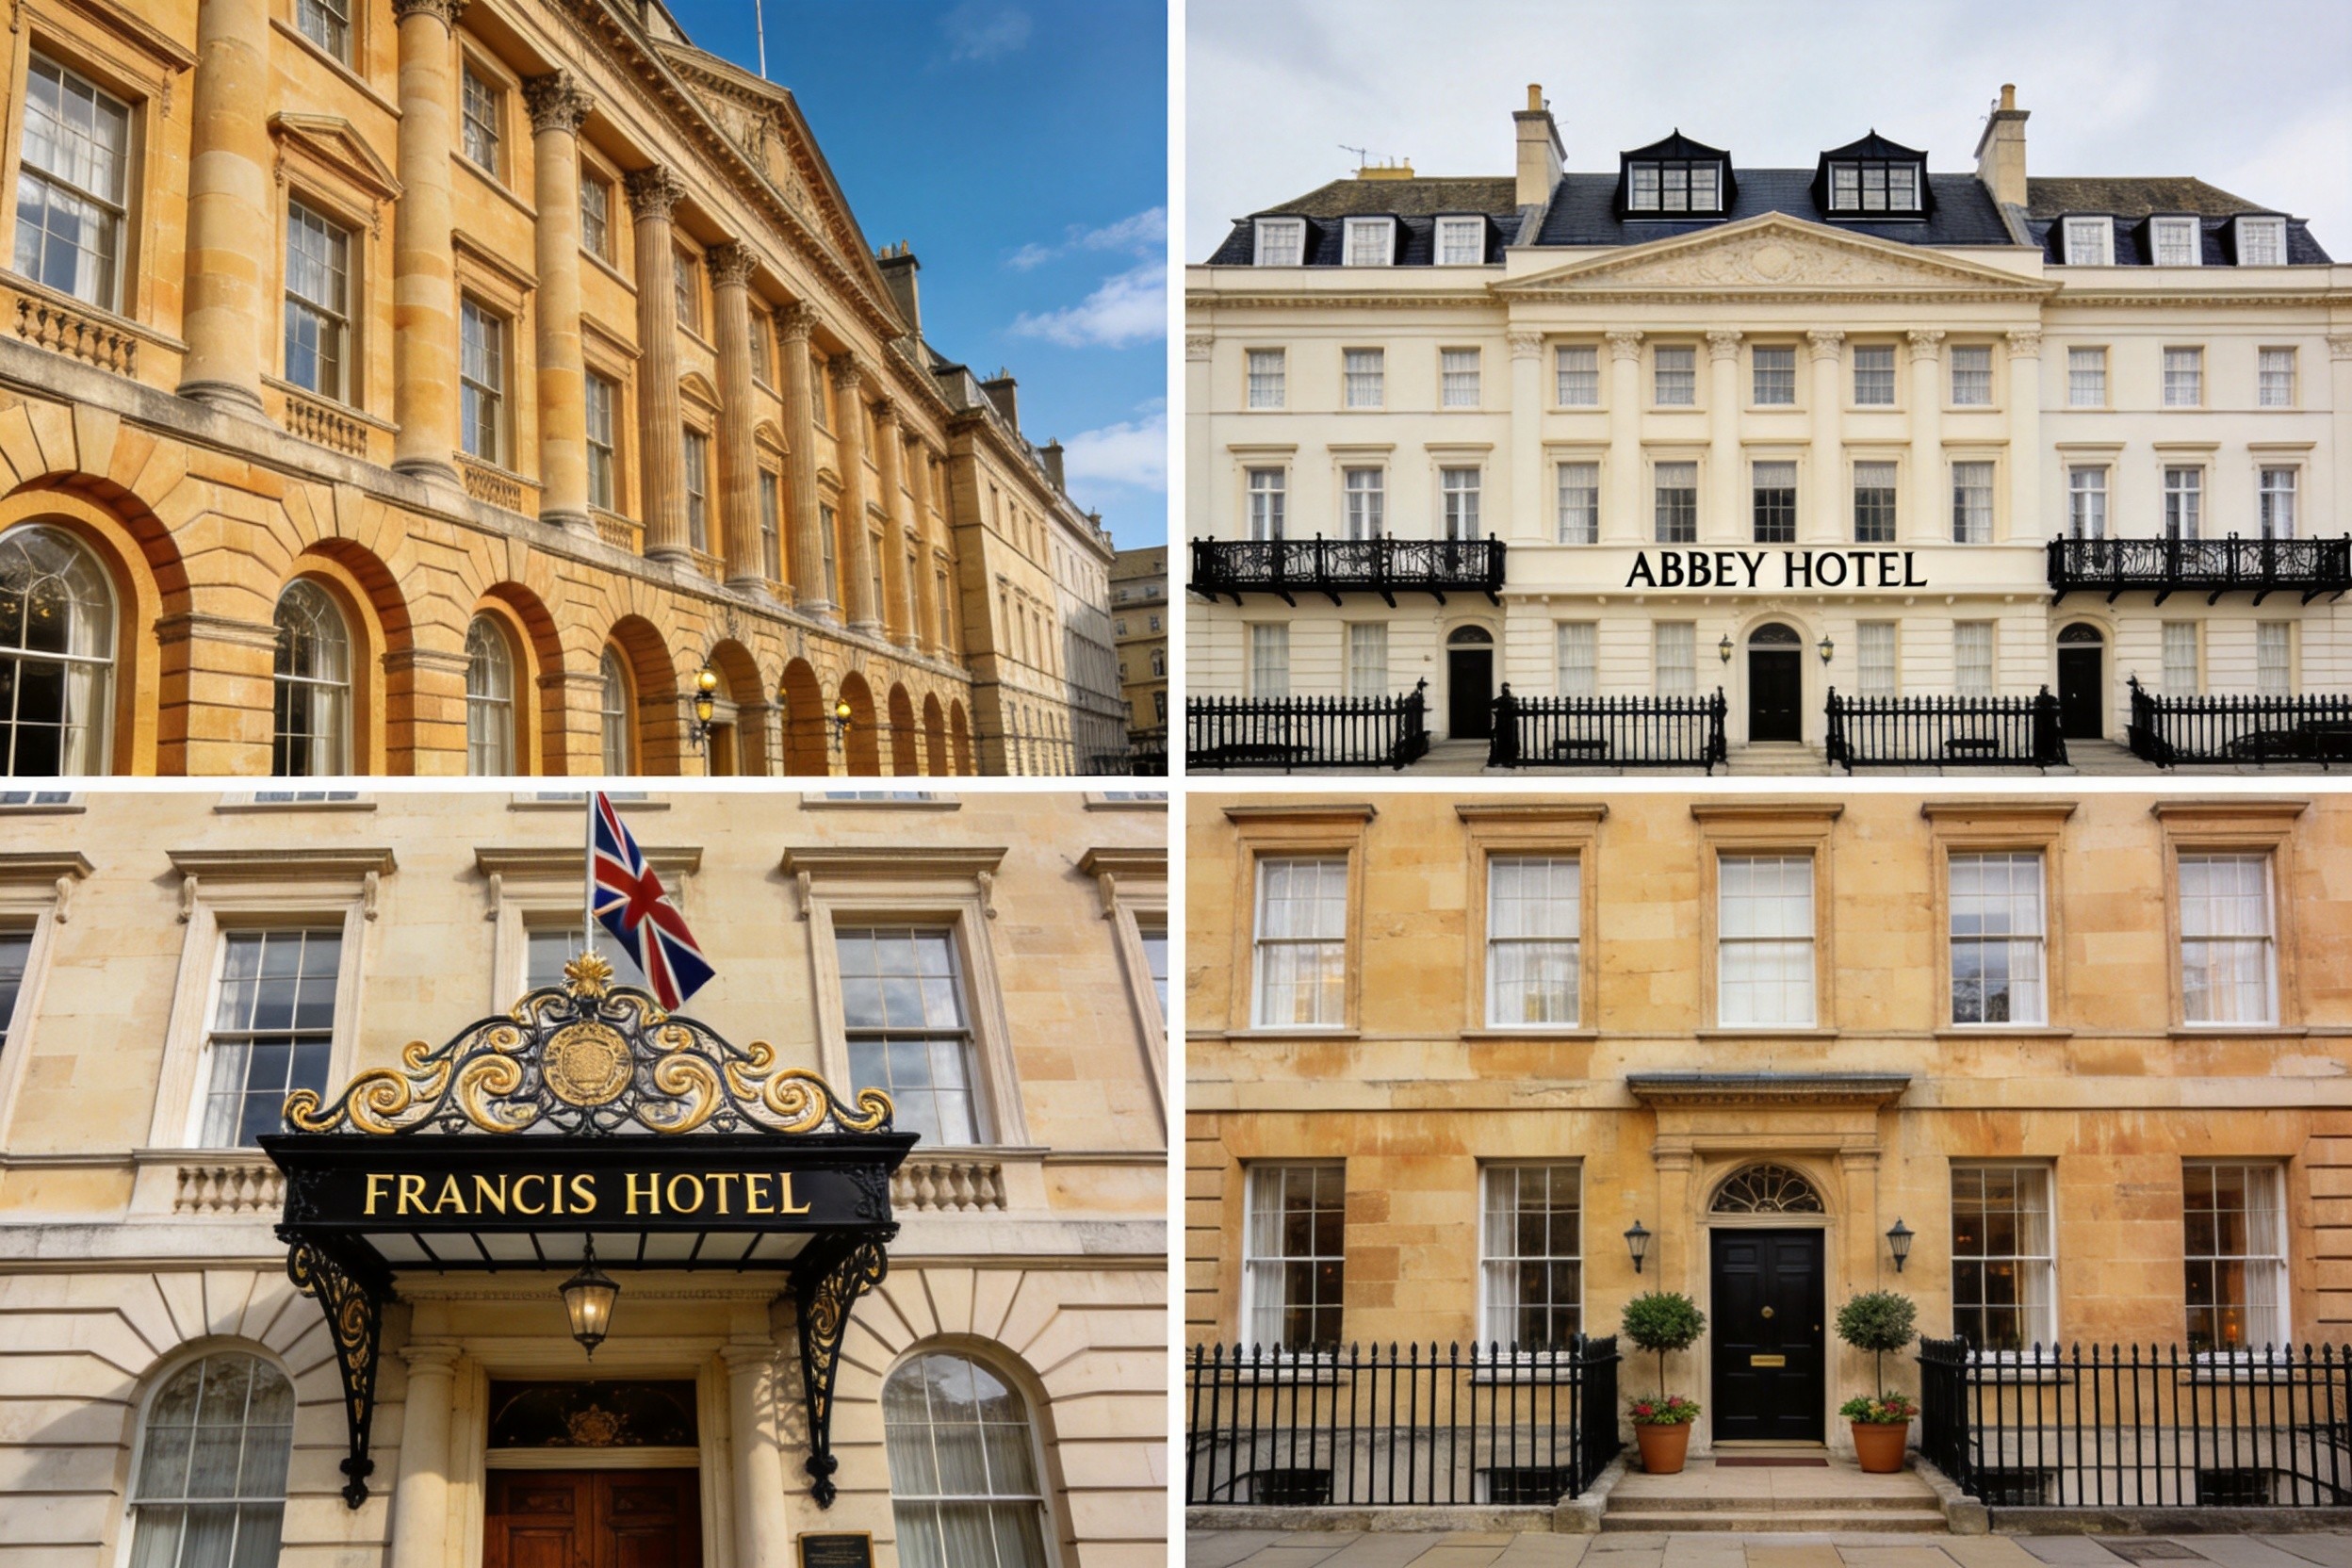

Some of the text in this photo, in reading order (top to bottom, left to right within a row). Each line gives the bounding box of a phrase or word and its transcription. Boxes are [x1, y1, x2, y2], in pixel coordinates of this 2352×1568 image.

[1625, 550, 1928, 588] ABBEY HOTEL
[363, 1172, 811, 1215] FRANCIS HOTEL
